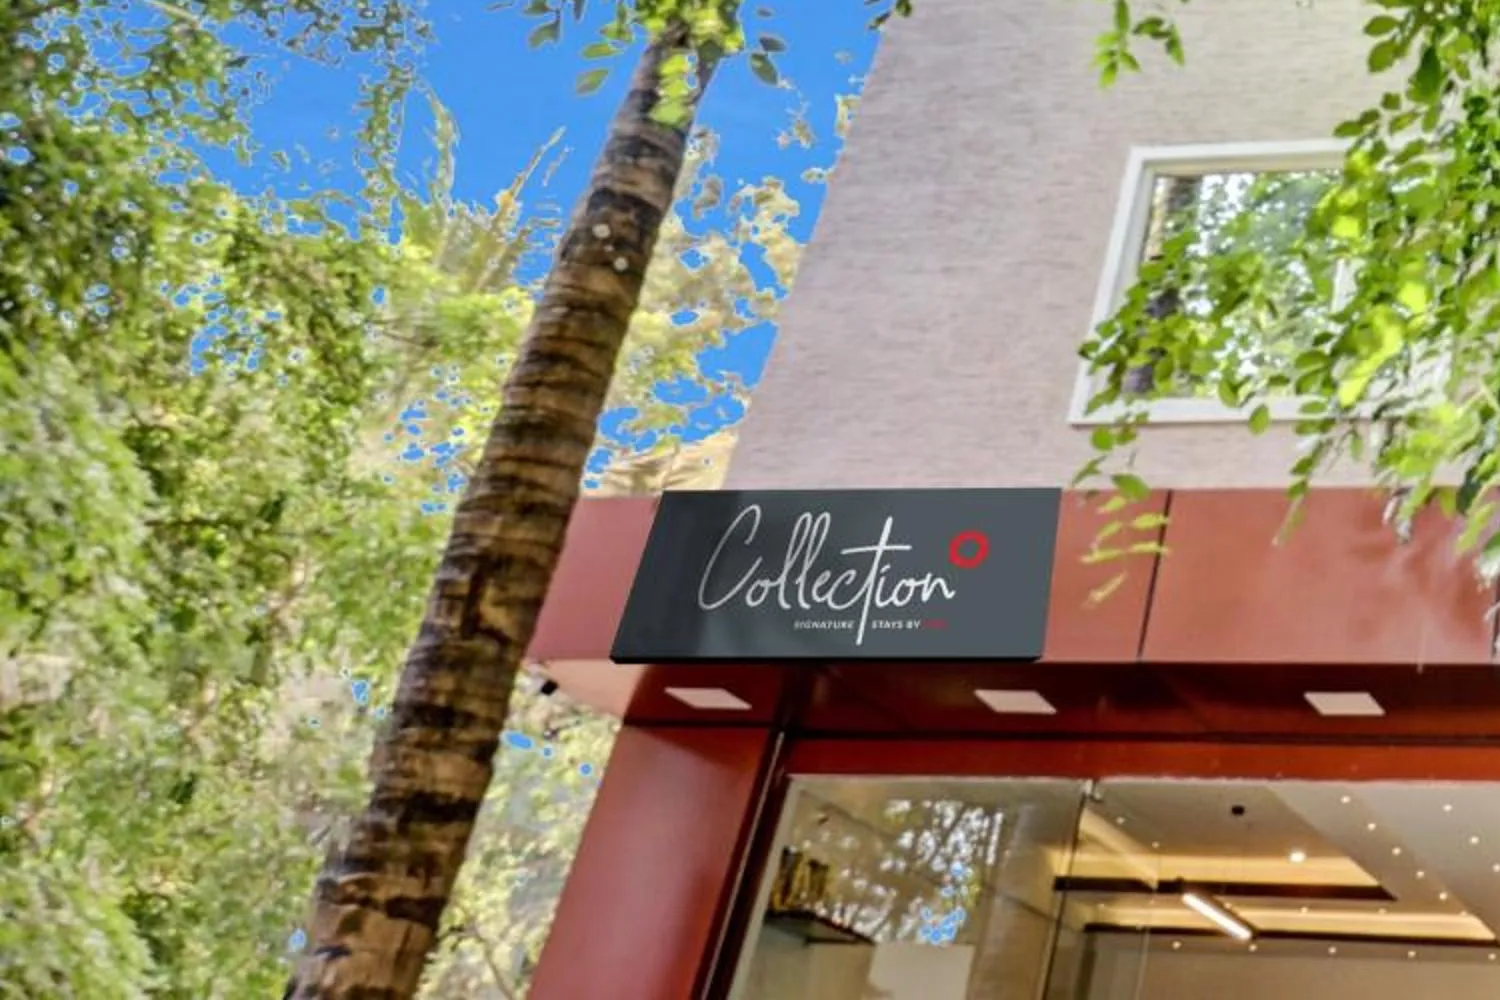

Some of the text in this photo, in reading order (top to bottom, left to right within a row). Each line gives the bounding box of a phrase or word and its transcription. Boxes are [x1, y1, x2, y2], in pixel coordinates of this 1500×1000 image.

[699, 504, 957, 645] Collection
[794, 619, 855, 630] SIGNATURE
[871, 619, 903, 630] STAYS
[906, 619, 922, 630] BY
